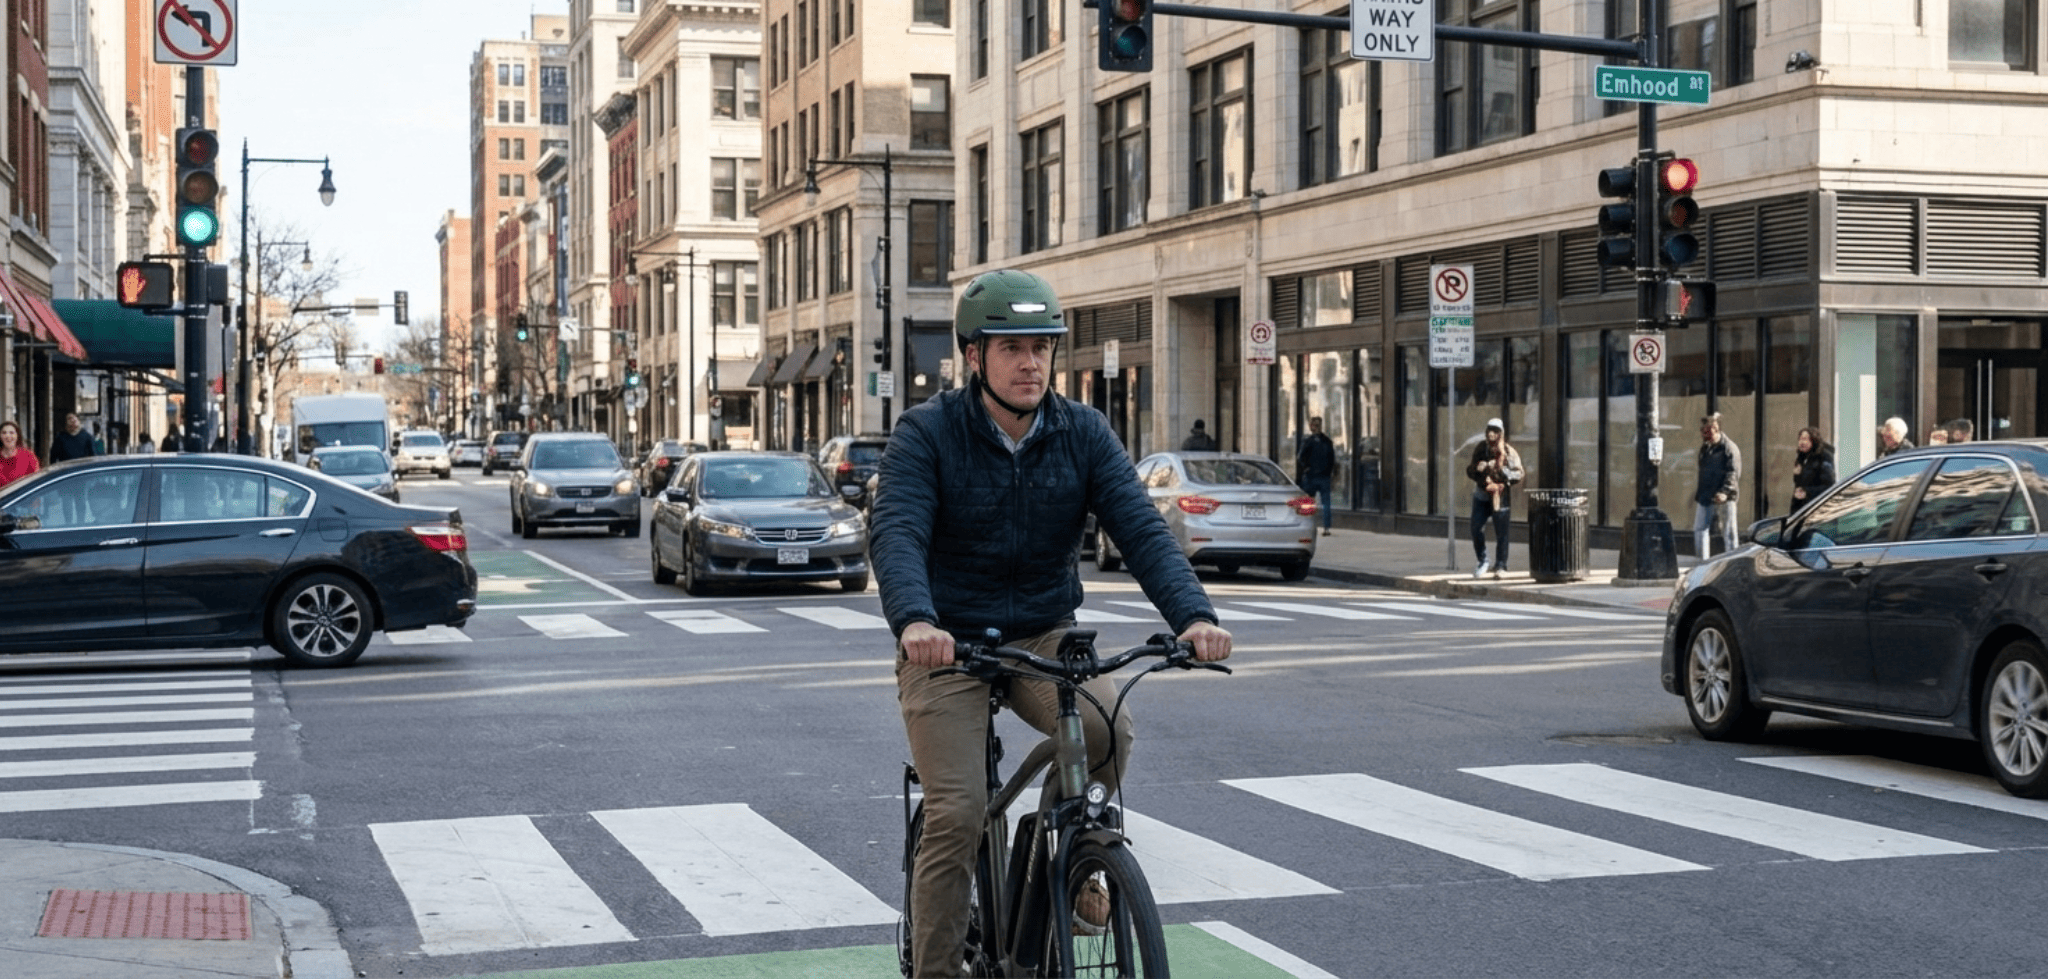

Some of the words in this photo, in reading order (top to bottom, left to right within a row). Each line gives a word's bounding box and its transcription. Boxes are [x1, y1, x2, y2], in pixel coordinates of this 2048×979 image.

[1369, 8, 1415, 28] WAY
[1364, 32, 1420, 53] ONLY
[1601, 72, 1679, 97] Emhood
